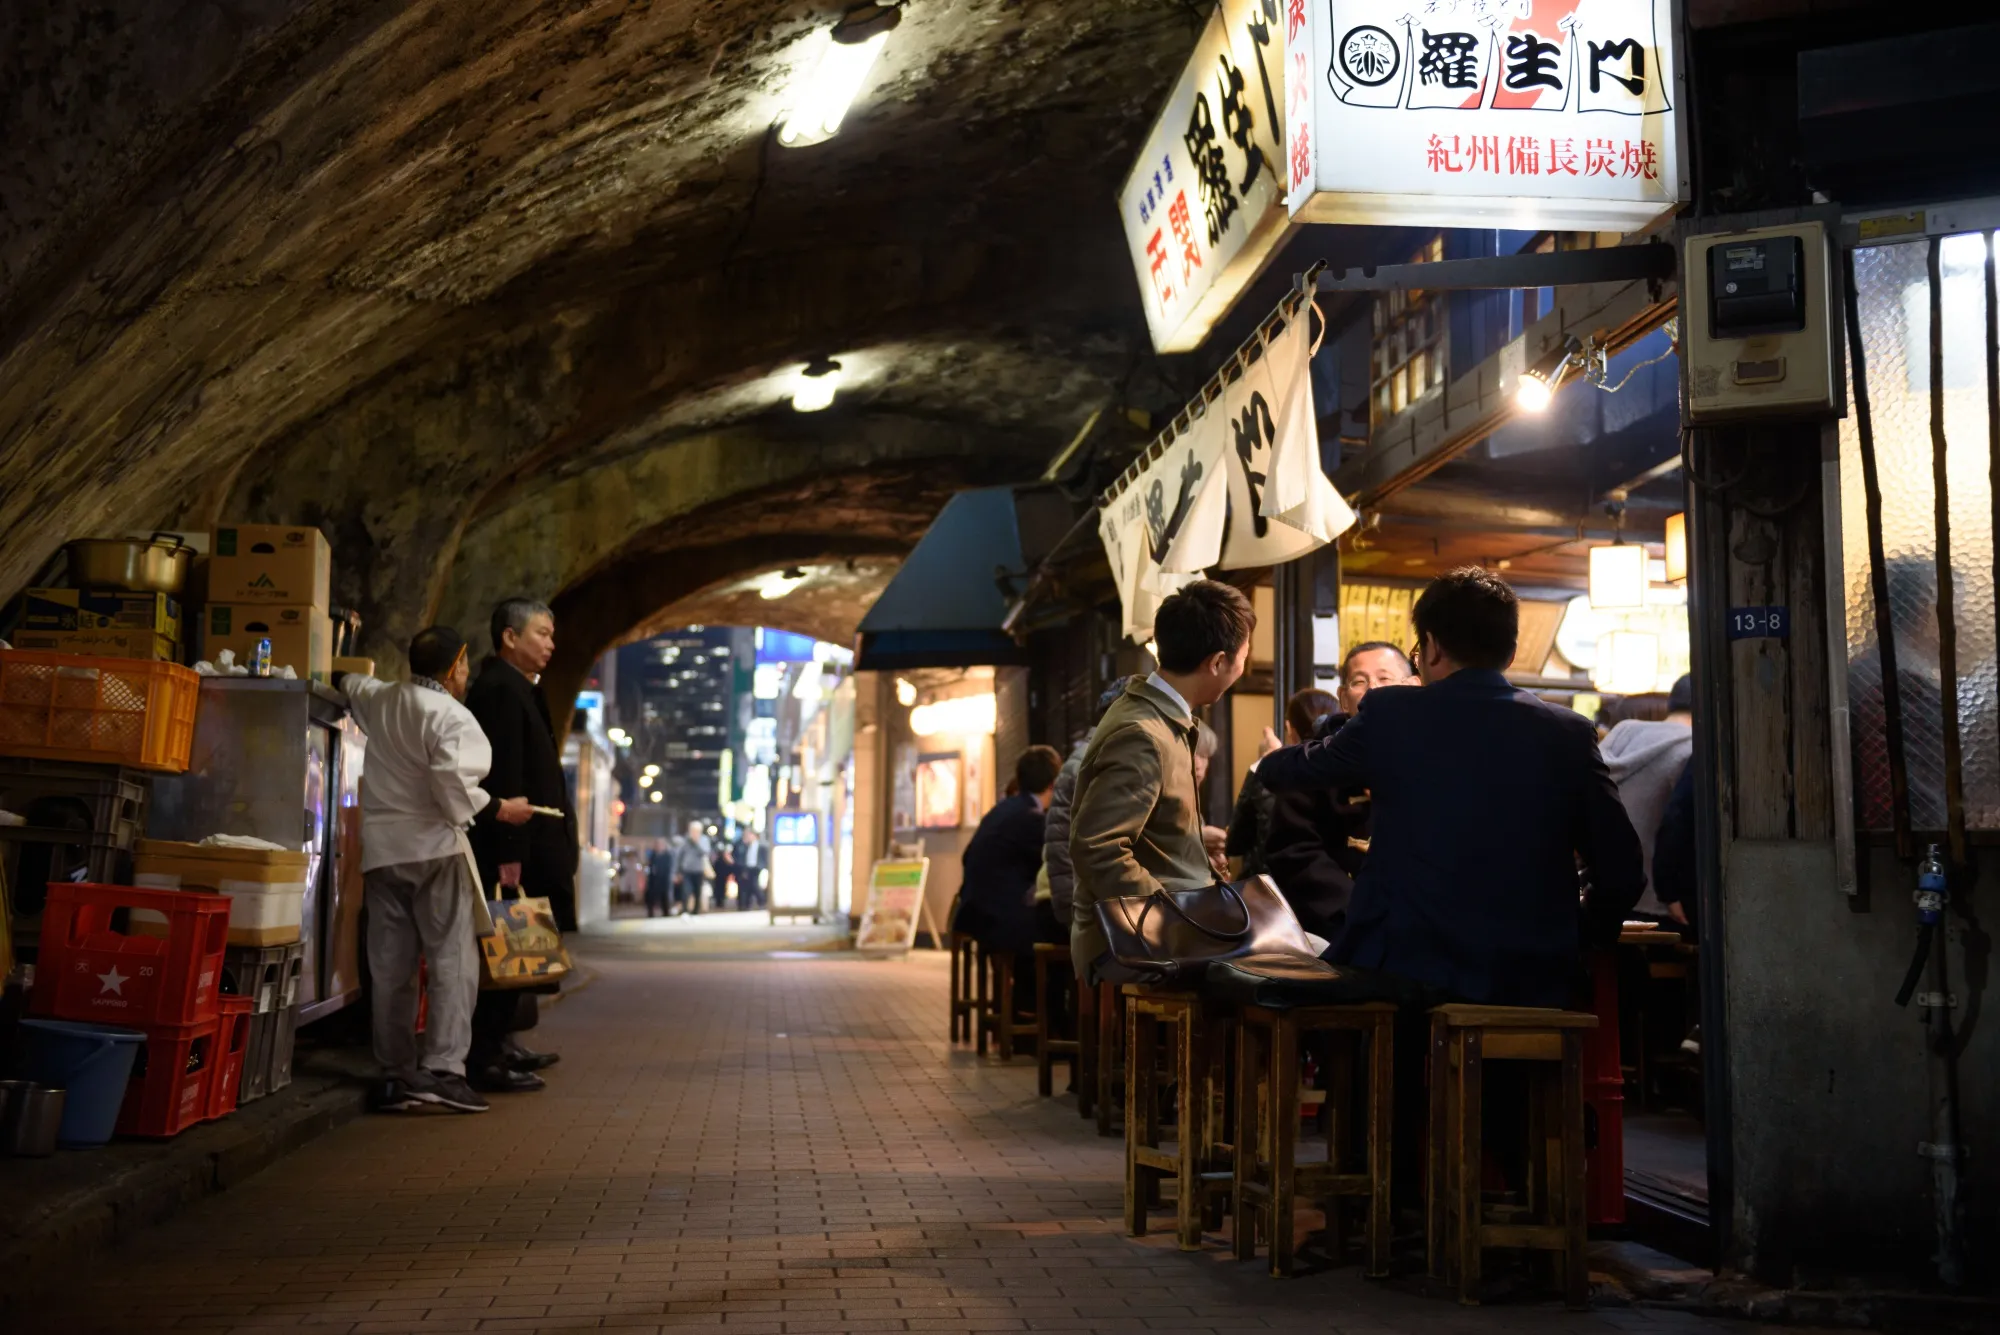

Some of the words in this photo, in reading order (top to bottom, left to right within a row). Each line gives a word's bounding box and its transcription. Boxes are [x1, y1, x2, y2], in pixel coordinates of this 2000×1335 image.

[1418, 28, 1645, 96] 羅生門
[1427, 133, 1658, 180] 紀州備長炭焼
[1734, 613, 1780, 631] 13-8
[139, 966, 154, 977] 20
[92, 997, 128, 1008] SAPPORO
